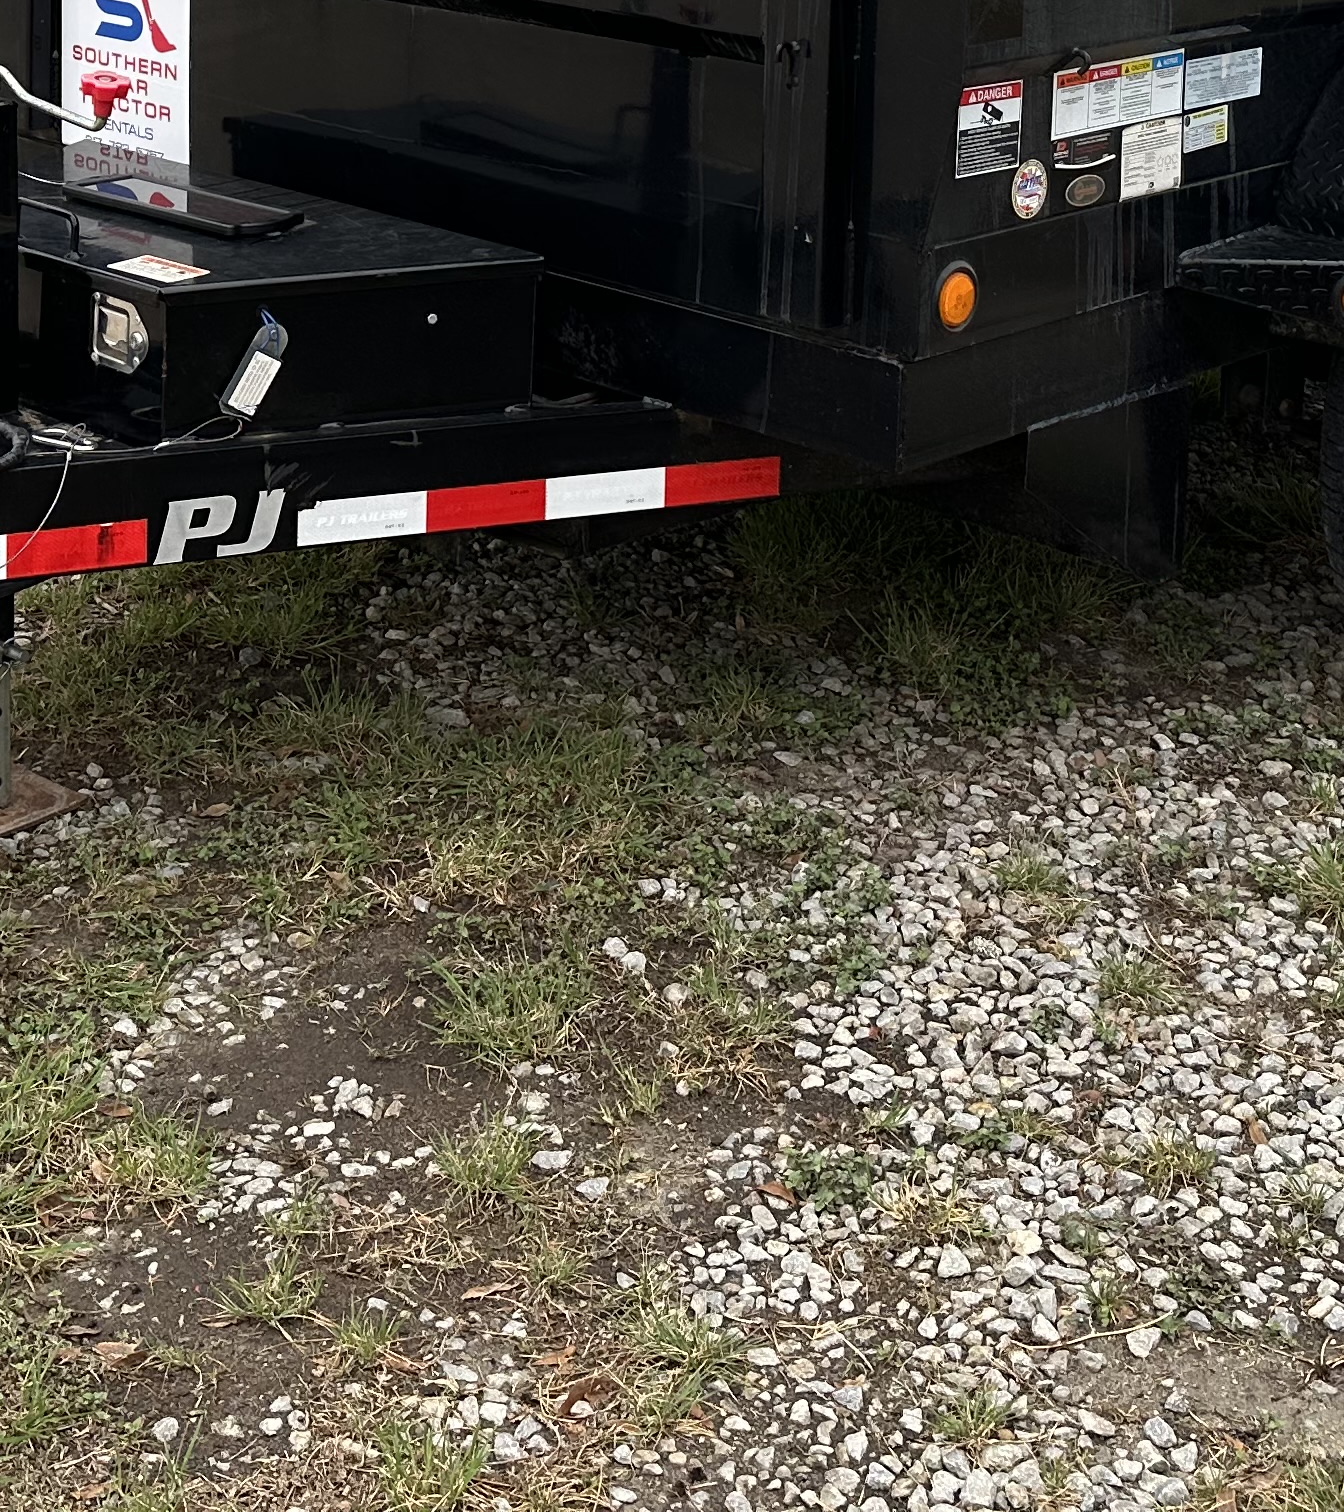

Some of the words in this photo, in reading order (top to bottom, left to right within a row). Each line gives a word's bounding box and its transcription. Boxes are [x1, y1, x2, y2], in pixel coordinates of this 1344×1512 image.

[72, 44, 178, 81] SOUTHERN
[977, 86, 1013, 101] DANGER
[105, 118, 154, 140] ENTALS
[153, 488, 286, 565] PJ
[316, 515, 336, 528] PJ
[340, 508, 408, 526] TRAILERS
